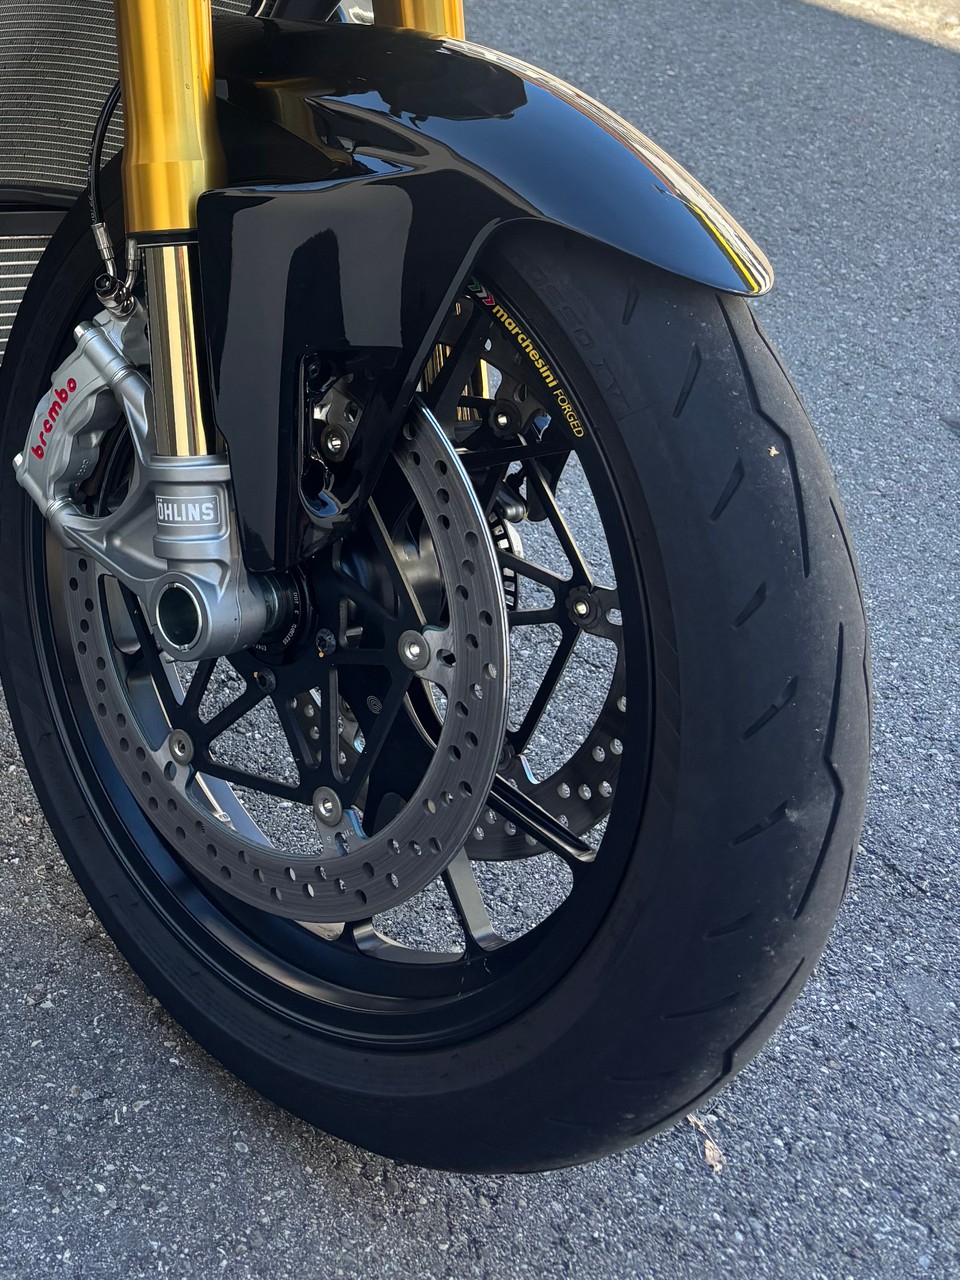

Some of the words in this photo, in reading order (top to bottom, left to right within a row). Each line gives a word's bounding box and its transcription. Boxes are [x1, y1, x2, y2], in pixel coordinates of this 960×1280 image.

[492, 305, 558, 388] marchesini
[553, 389, 584, 438] FORGED
[31, 377, 77, 460] brembo
[157, 498, 215, 521] ÖHLINS
